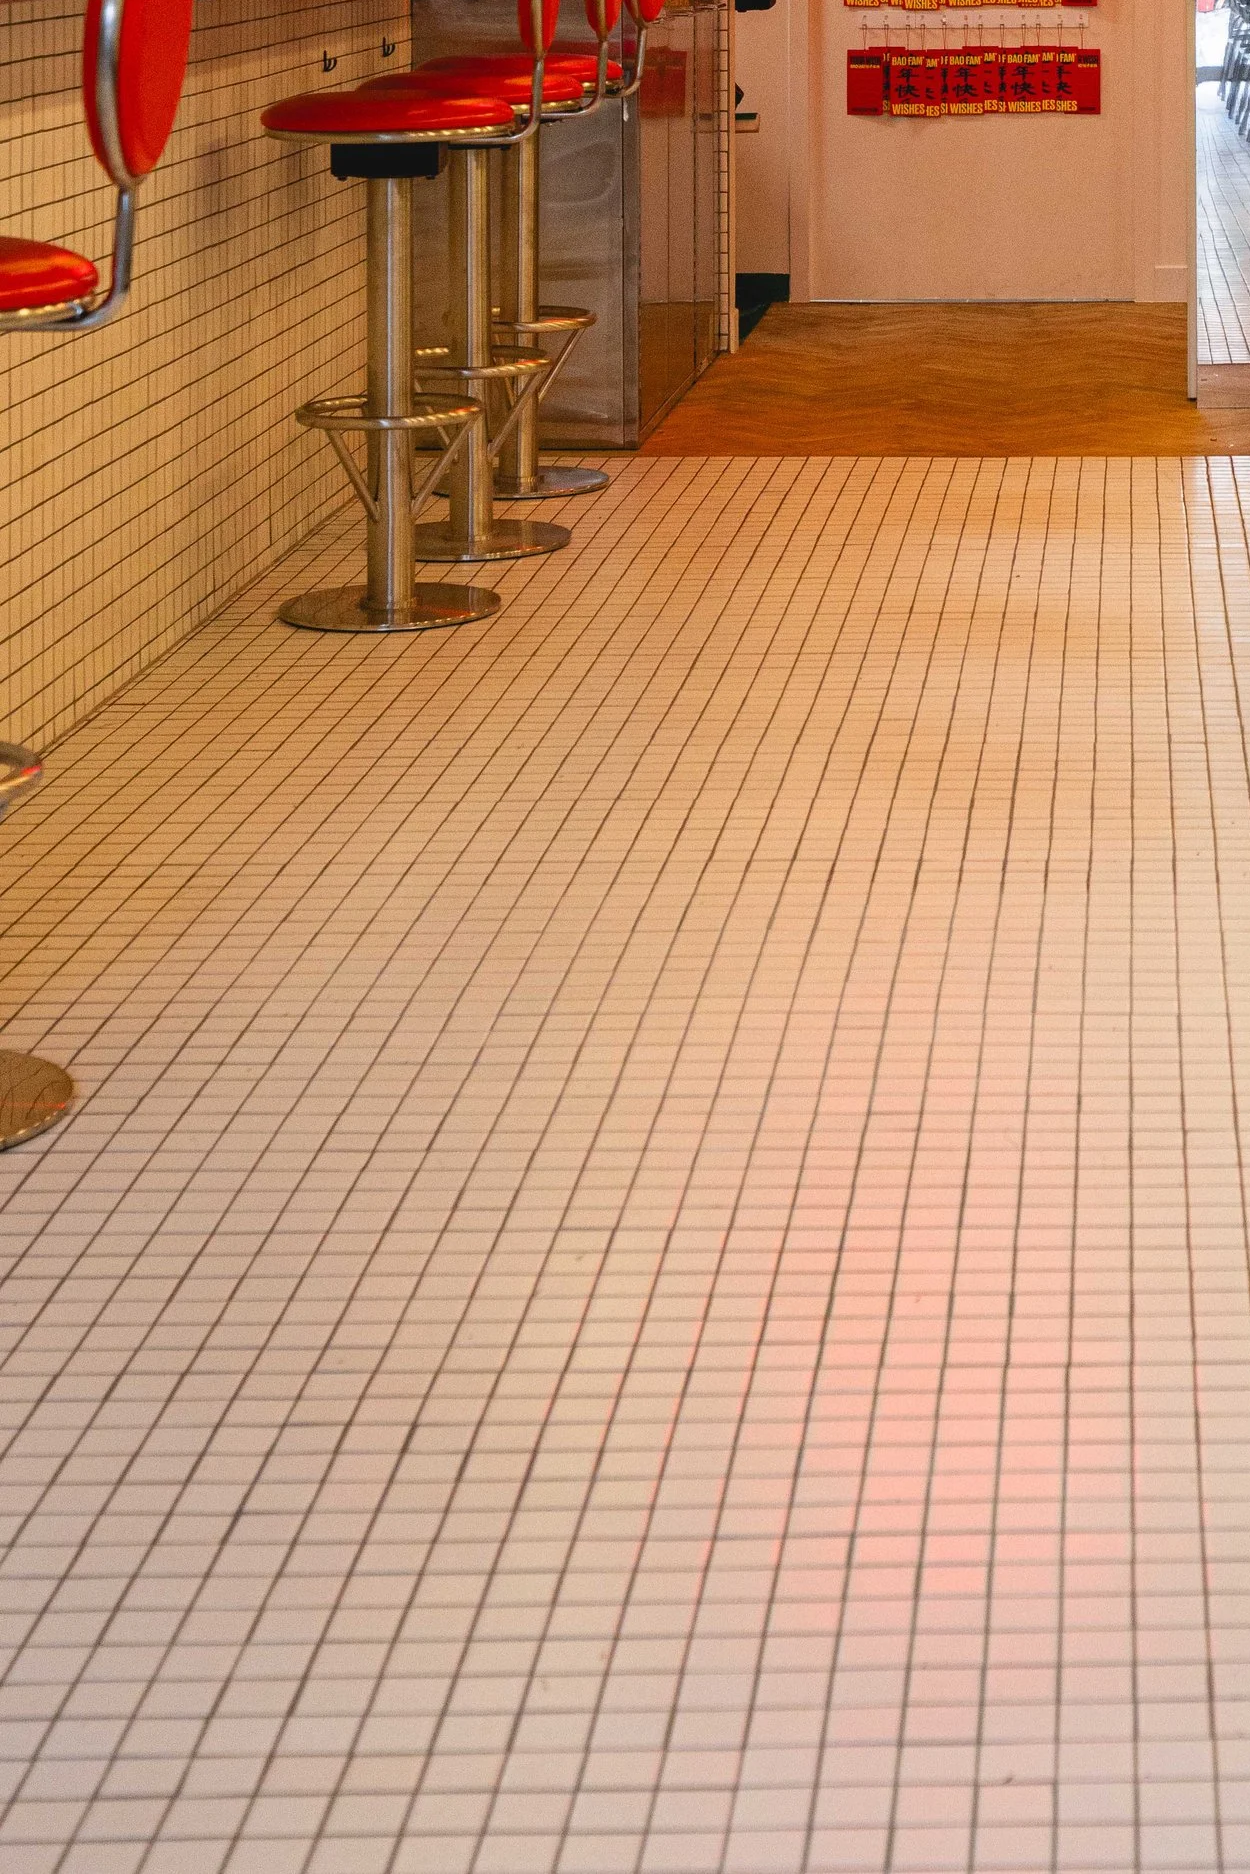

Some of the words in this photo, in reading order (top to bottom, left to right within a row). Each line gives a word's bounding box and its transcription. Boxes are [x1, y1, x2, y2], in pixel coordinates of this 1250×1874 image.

[892, 56, 906, 65] BAO
[950, 56, 964, 65] BAO
[1008, 54, 1022, 63] BAO
[892, 104, 925, 115] WISHES
[950, 102, 983, 114] WISHES
[1008, 101, 1041, 112] WISHES
[1056, 100, 1077, 111] SHES
